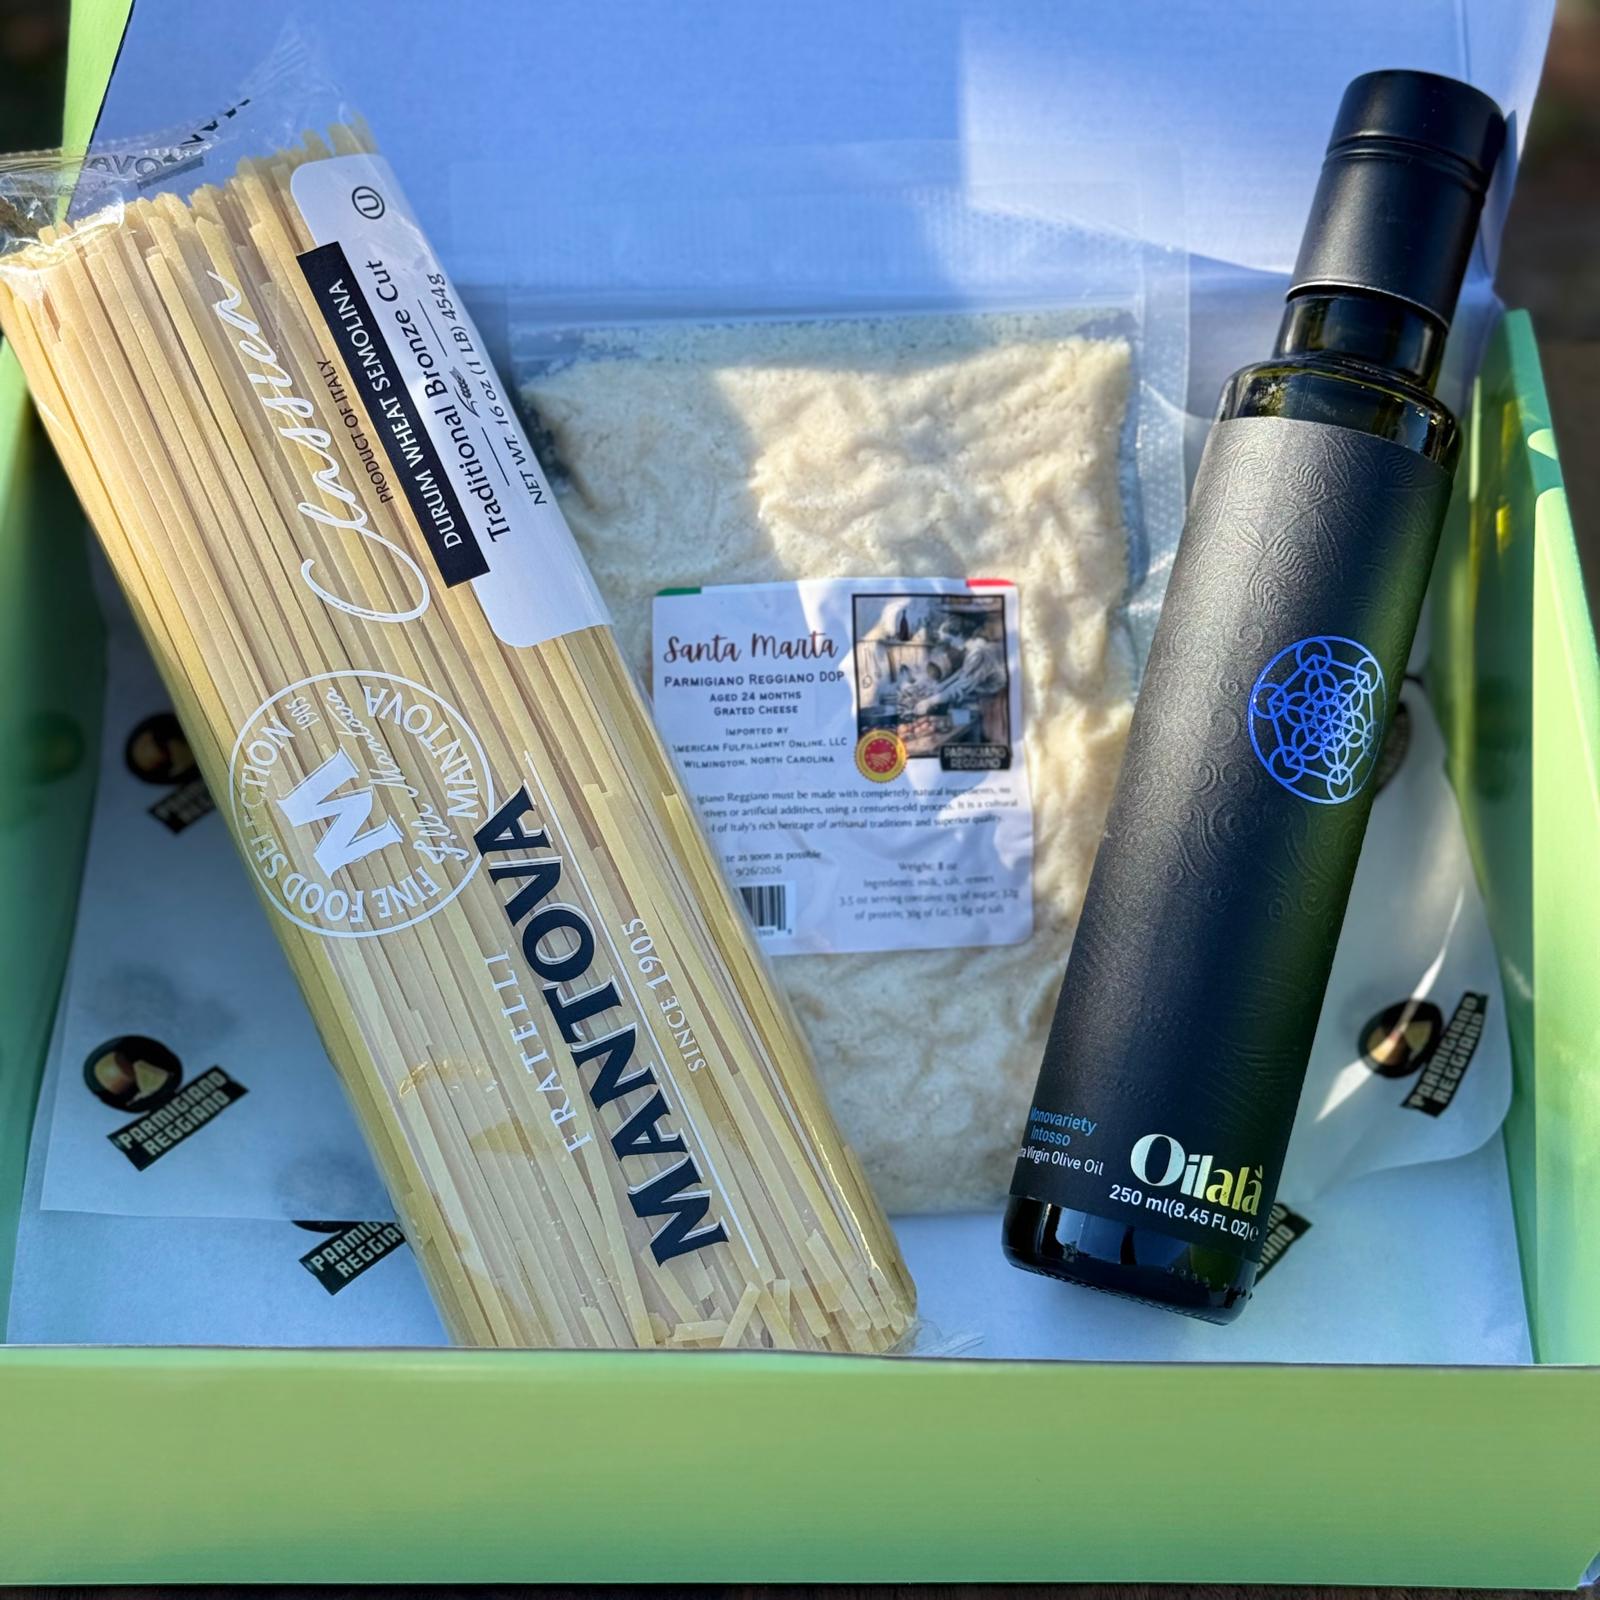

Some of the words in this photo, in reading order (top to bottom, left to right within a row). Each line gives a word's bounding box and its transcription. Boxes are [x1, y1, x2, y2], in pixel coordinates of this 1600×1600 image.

[365, 260, 400, 303] Cut
[426, 272, 457, 322] 454g
[329, 278, 391, 392] SEMOLINA
[397, 309, 448, 399] Bronze
[450, 326, 474, 353] LB)
[316, 359, 347, 406] ITALY
[466, 361, 487, 376] (1
[480, 379, 497, 401] oz
[339, 408, 358, 429] OF
[379, 398, 424, 467] WHEAT
[489, 405, 509, 426] 16
[206, 269, 431, 624] Classica
[351, 432, 394, 504] PRODUCT
[504, 433, 527, 466] WT.
[434, 405, 511, 542] Traditional
[519, 470, 548, 506] NET
[415, 469, 463, 549] DURUM
[663, 634, 742, 664] Santa
[751, 630, 839, 660] Marta
[664, 676, 744, 687] PARMIGIANO
[749, 673, 814, 685] REGGIANO
[819, 671, 845, 682] DOP
[709, 693, 738, 703] AGED
[741, 692, 755, 702] 24
[759, 691, 802, 701] MONTHS
[284, 696, 321, 731] 1905
[714, 707, 755, 716] GRATED
[758, 706, 799, 715] CHEESE
[725, 728, 773, 736] IMPORTED
[325, 687, 419, 798] Mantova
[362, 685, 480, 820] MANTOVA
[750, 757, 783, 765] NORTH
[786, 755, 835, 764] CAROLINA
[829, 737, 847, 747] LLC
[697, 793, 725, 806] igiano
[727, 792, 769, 803] Reggiano
[772, 792, 795, 800] must
[797, 790, 809, 799] be
[811, 790, 836, 799] made
[838, 789, 859, 798] with
[861, 787, 911, 799] completely
[913, 786, 943, 796] natural
[741, 806, 778, 816] artificial
[780, 806, 823, 816] additives,
[825, 806, 849, 816] using
[859, 803, 917, 814] centuries-old
[718, 823, 728, 832] of
[730, 821, 757, 834] Italy's
[759, 820, 775, 830] rich
[778, 820, 815, 832] heritage
[817, 820, 827, 829] of
[829, 818, 867, 828] artisanal
[869, 819, 912, 829] traditions
[915, 818, 931, 826] and
[281, 872, 365, 924] FOOD
[371, 865, 442, 918] FINE
[619, 916, 671, 990] 1905
[473, 780, 731, 1268] MANTOVA
[659, 994, 706, 1074] SINCE
[483, 949, 594, 1155] FRATELLI
[1408, 996, 1478, 1107] PARMIGIANO
[1432, 1012, 1484, 1104] REGGIANO
[118, 1071, 228, 1150] PARMIGIANO
[142, 1091, 231, 1156] REGGIANO
[1030, 1106, 1098, 1137] Monovariety
[1030, 1124, 1071, 1147] Intosso
[1026, 1145, 1050, 1165] Virgin
[1051, 1150, 1081, 1170] Olive
[1084, 1158, 1104, 1176] Oil
[1130, 1133, 1264, 1216] Oilalà
[1109, 1184, 1143, 1206] 250
[1211, 1212, 1229, 1232] FL
[335, 1224, 402, 1279] REGGIA
